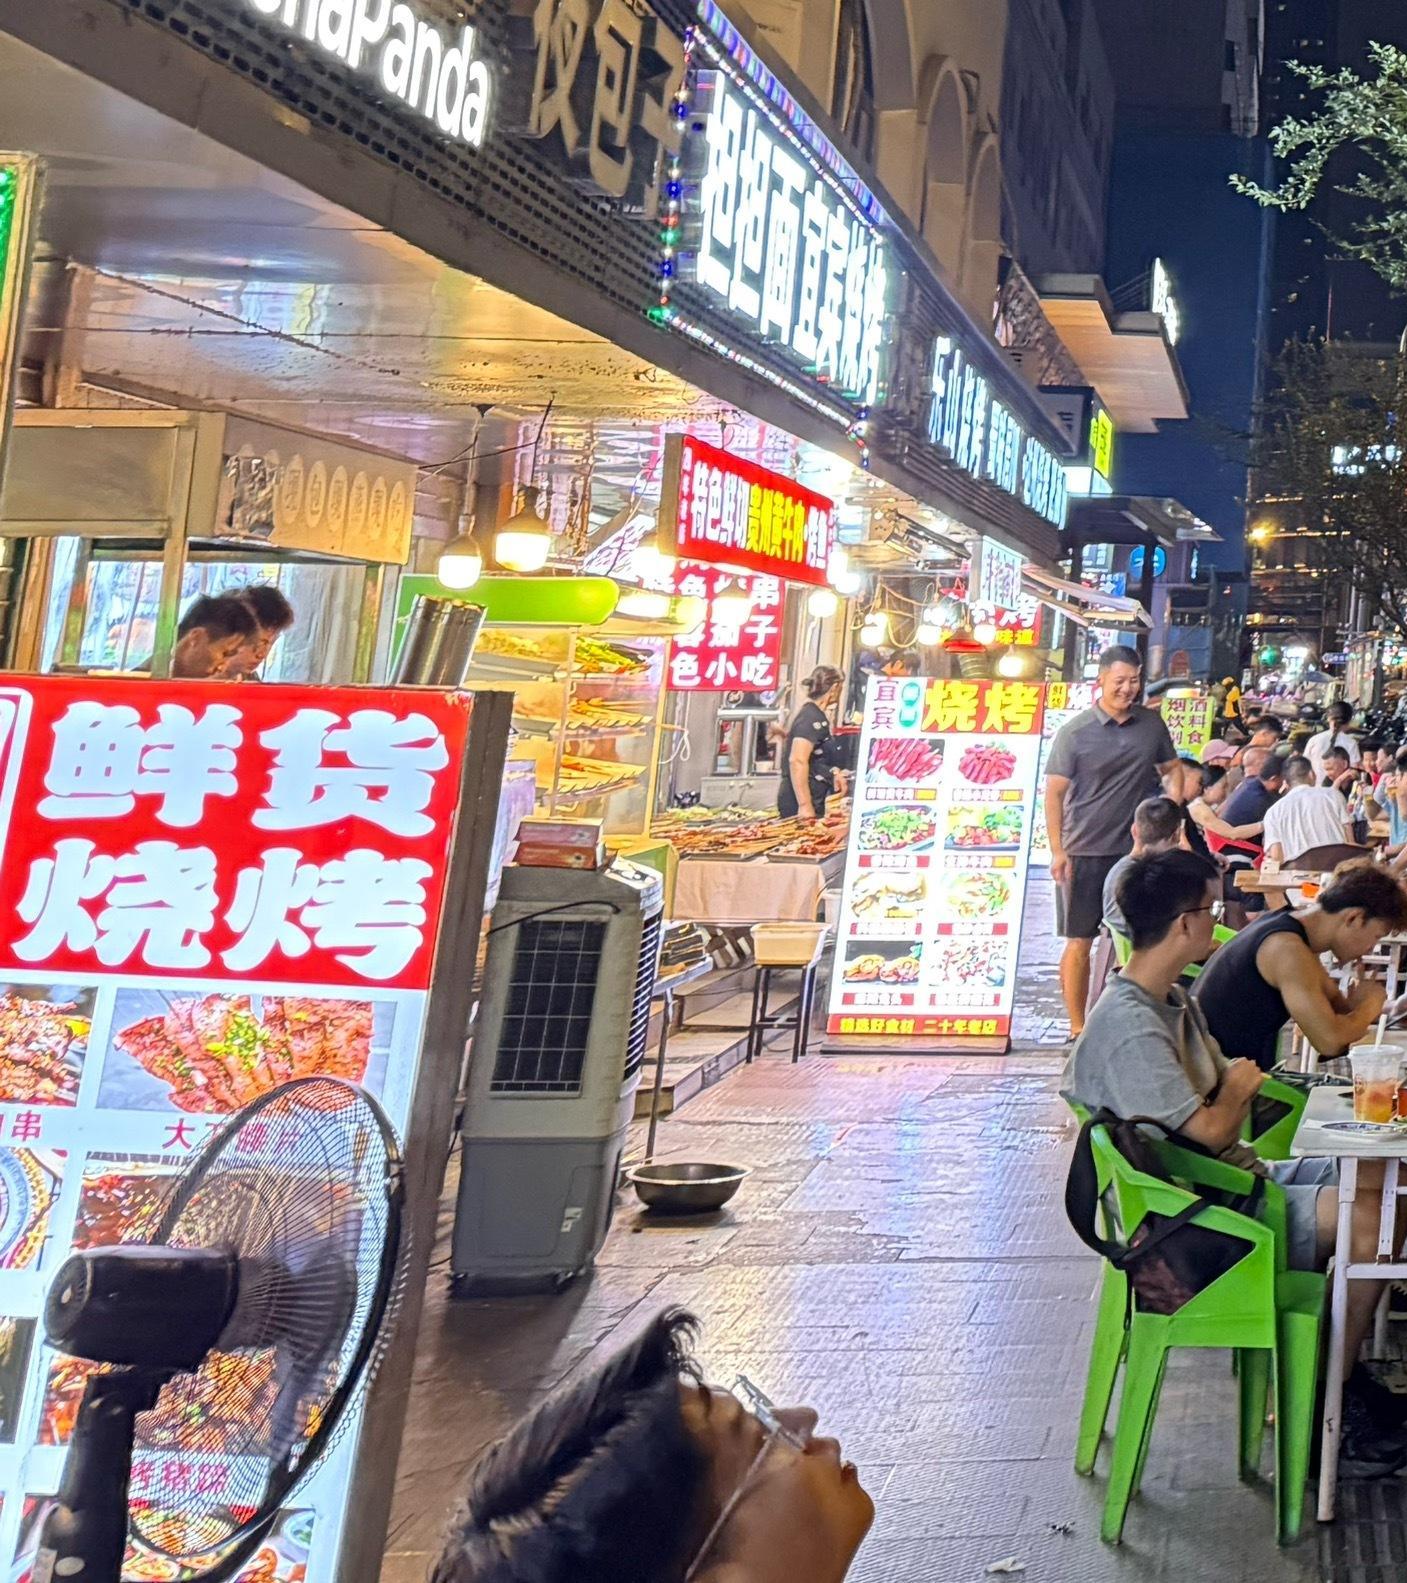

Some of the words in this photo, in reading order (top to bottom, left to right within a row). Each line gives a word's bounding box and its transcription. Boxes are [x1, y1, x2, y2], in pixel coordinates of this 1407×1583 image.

[669, 651, 774, 687] 色小吃
[871, 680, 899, 730] 宜宾
[922, 679, 1039, 733] 烧烤
[1167, 699, 1208, 712] 烟酒
[1167, 714, 1206, 729] 饮料
[36, 700, 450, 838] 鲜货
[11, 838, 435, 981] 烧烤
